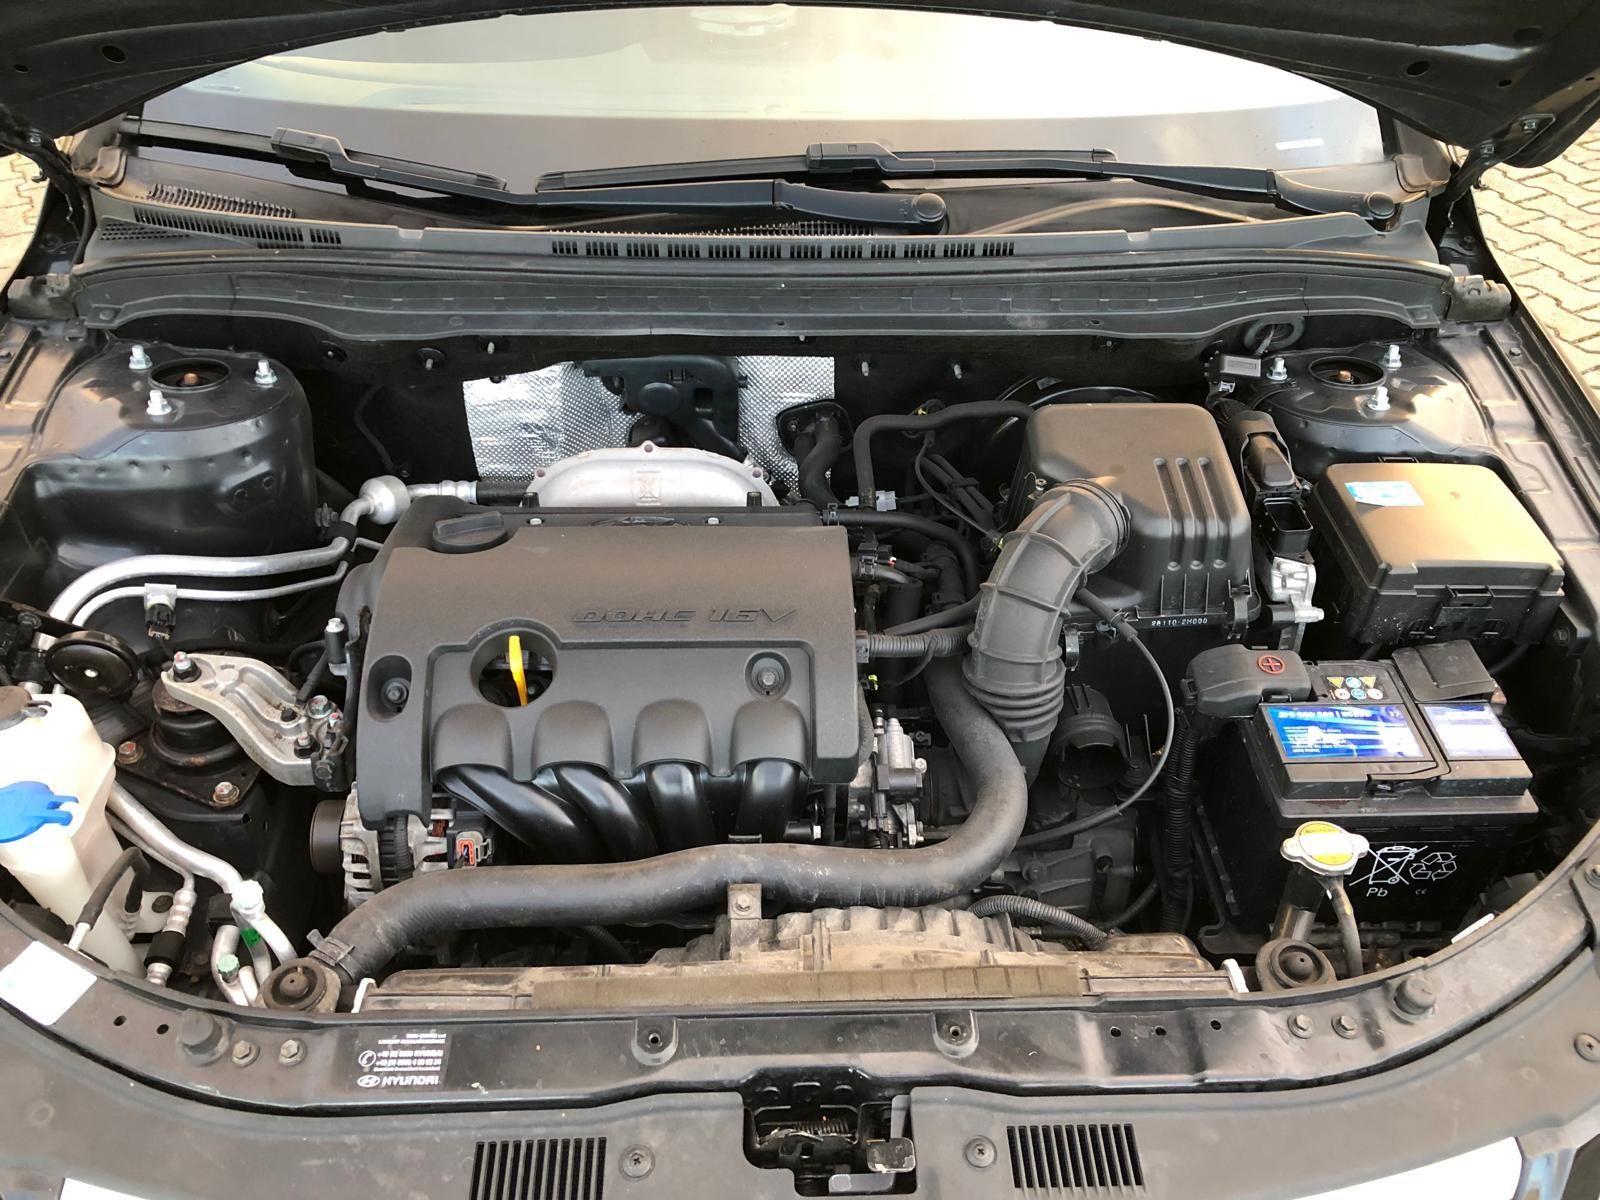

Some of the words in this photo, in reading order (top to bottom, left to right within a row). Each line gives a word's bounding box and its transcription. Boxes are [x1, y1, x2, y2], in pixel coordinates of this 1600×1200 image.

[571, 608, 697, 623] DOHC
[709, 607, 798, 623] 16V
[1366, 887, 1388, 897] Pb
[382, 1075, 439, 1086] HYUNDAI
